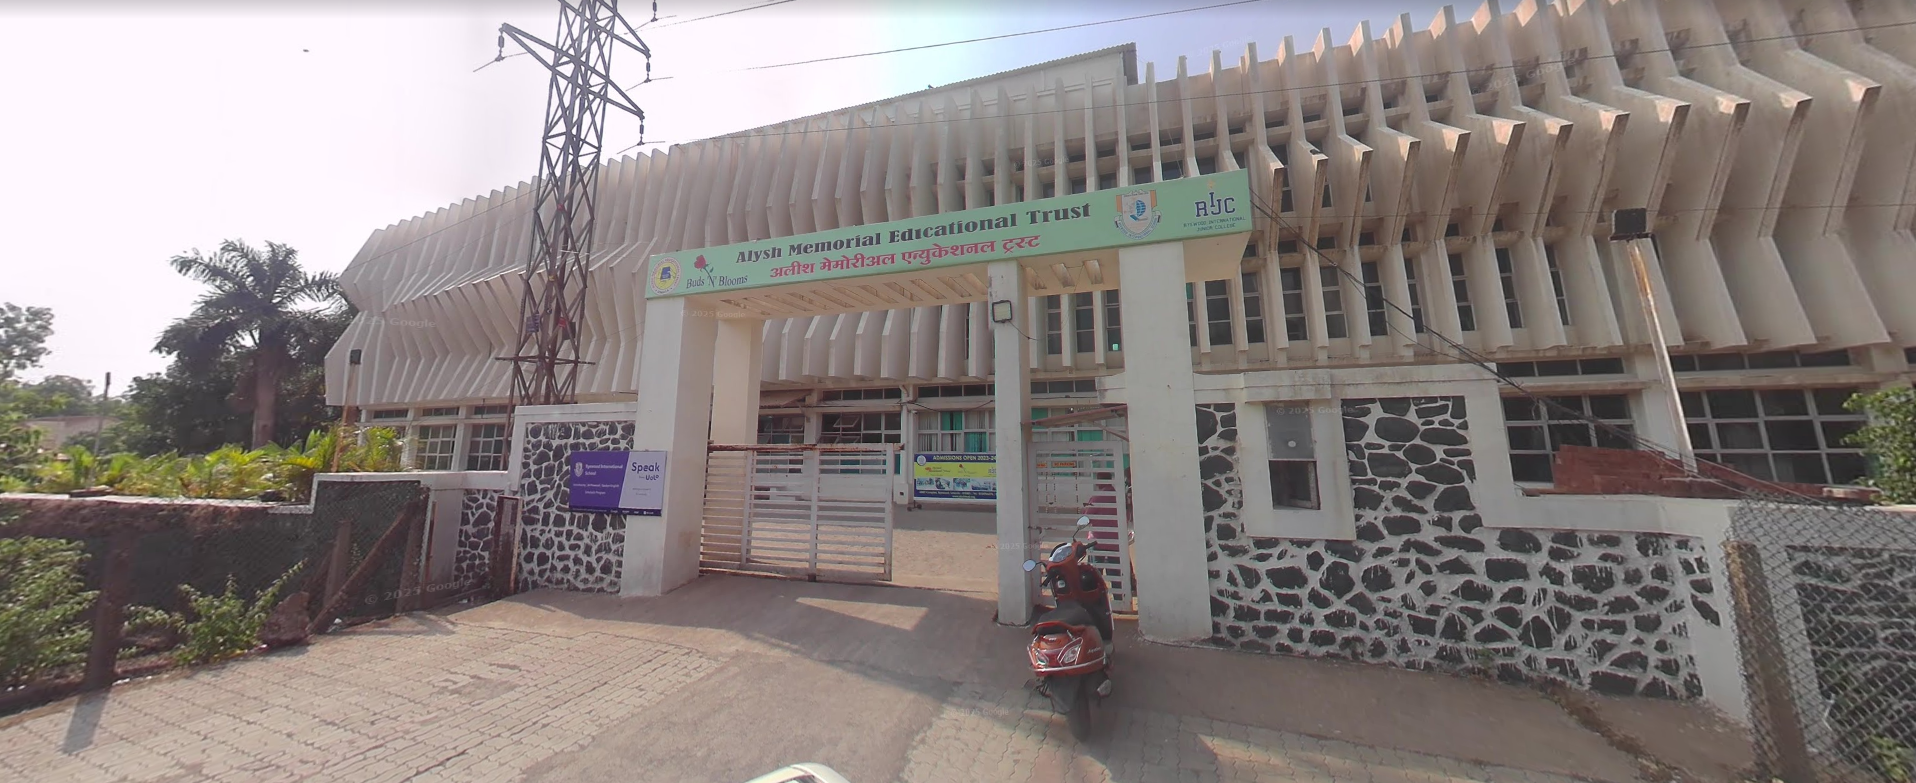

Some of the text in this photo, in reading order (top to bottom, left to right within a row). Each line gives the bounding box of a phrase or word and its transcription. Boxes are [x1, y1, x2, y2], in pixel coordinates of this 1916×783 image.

[736, 247, 782, 263] Alysh
[788, 232, 881, 256] Memorial
[1026, 202, 1091, 225] Trust
[1214, 222, 1236, 230] COLLEGE
[770, 260, 816, 278] अलीश
[819, 252, 896, 272] मेमोरीअल
[1001, 234, 1041, 254] ट्रस्ट
[686, 276, 705, 289] Buds
[718, 274, 748, 287] Blooms
[631, 461, 660, 474] Speak
